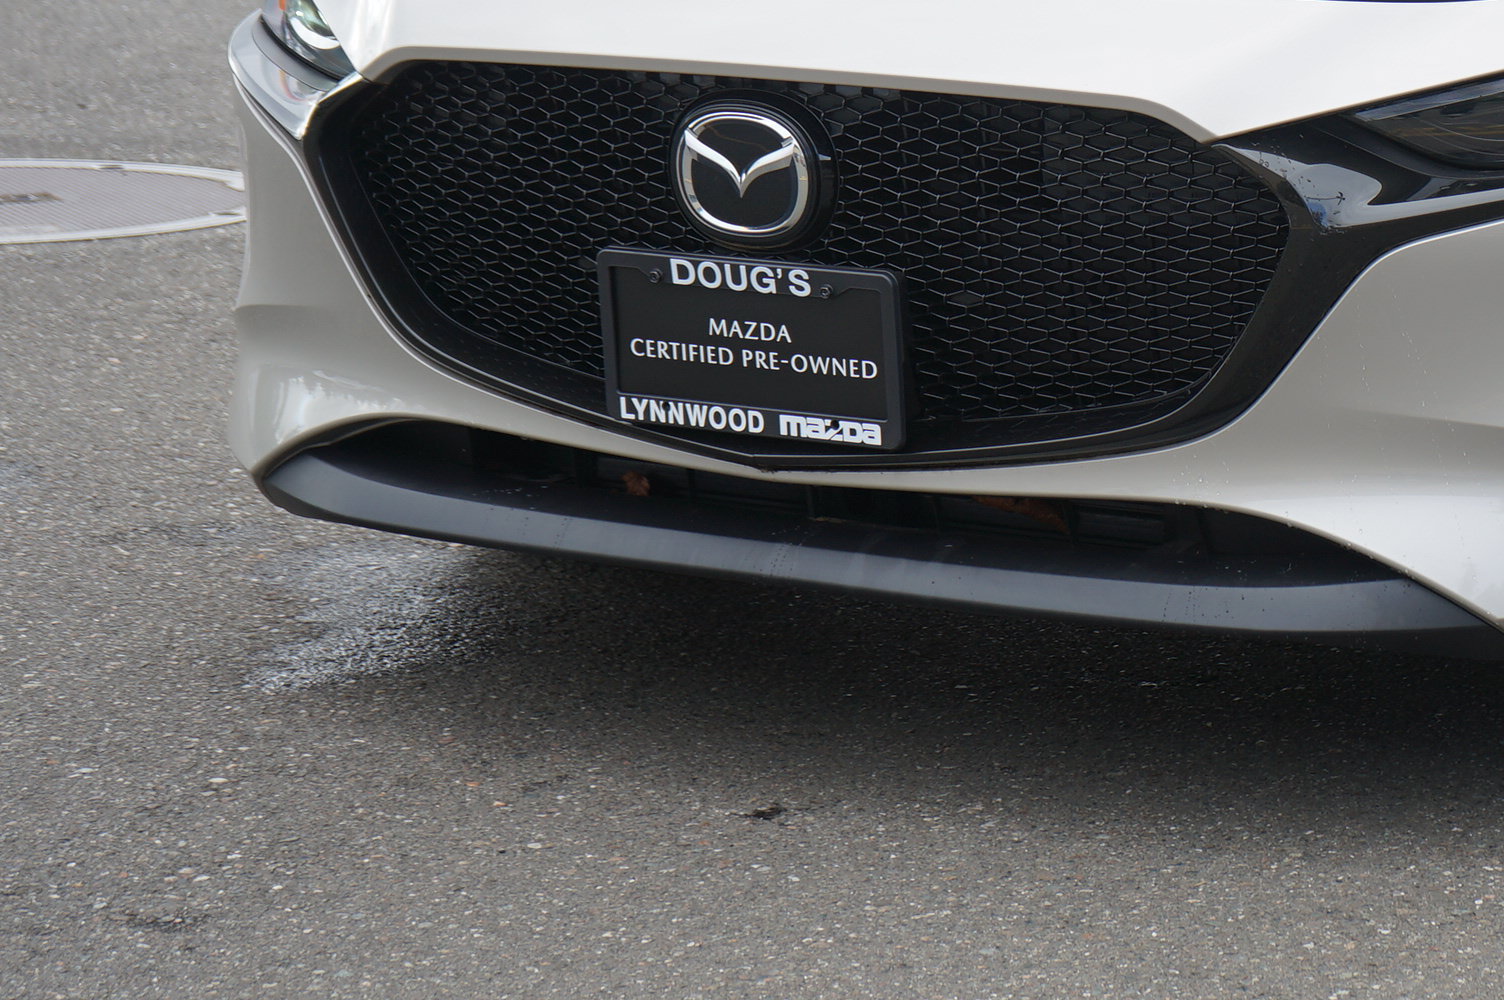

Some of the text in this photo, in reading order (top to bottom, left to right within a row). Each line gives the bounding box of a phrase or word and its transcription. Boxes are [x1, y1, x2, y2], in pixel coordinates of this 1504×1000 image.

[670, 258, 811, 297] DOUG'S
[708, 318, 792, 343] MAZDA
[630, 338, 878, 379] CERTIFIED PRE-OWNED
[619, 396, 764, 434] LYNNWOOD
